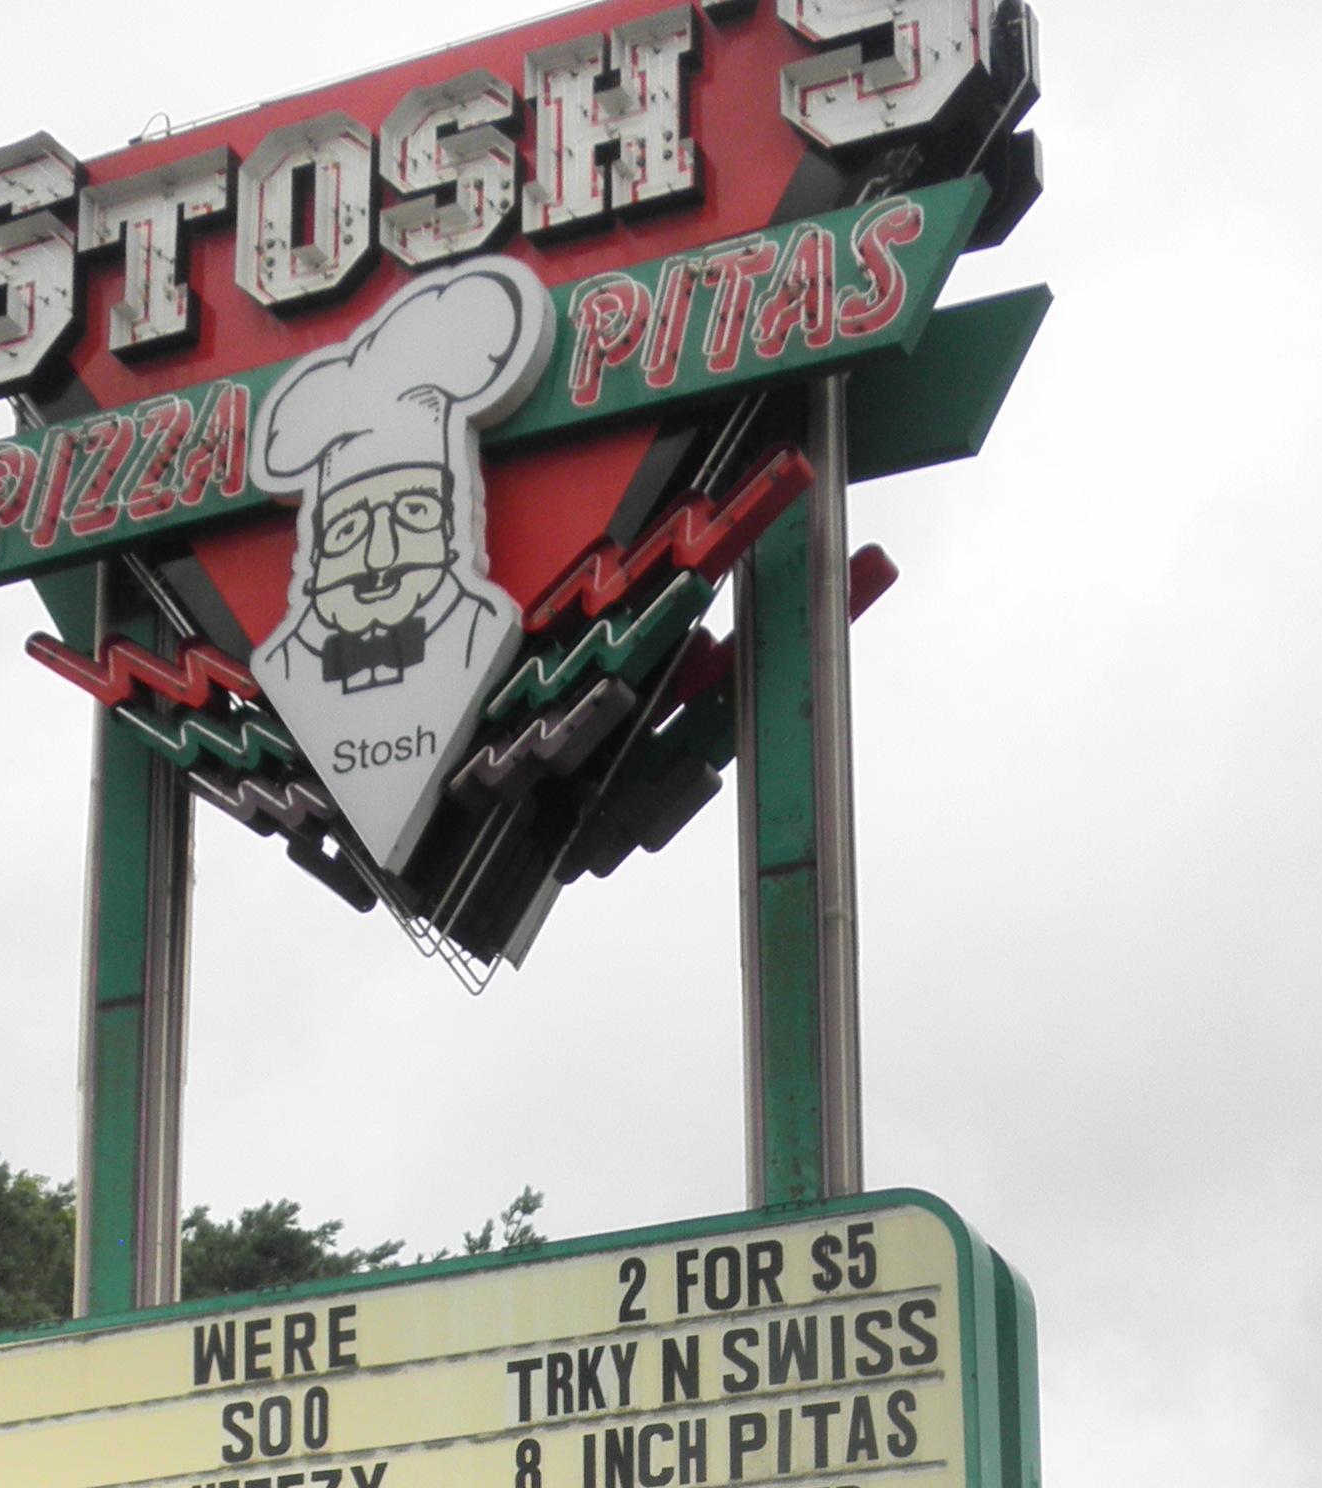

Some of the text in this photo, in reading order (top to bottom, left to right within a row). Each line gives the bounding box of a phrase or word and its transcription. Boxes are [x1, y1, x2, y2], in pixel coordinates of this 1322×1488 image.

[568, 195, 925, 406] PITAS
[332, 724, 437, 774] Stosh
[619, 1221, 878, 1323] 2 FOR $5
[193, 1303, 357, 1386] WERE
[506, 1298, 939, 1423] TRKY N SWISS
[221, 1385, 329, 1463] SOO
[729, 1388, 918, 1481] PITAS
